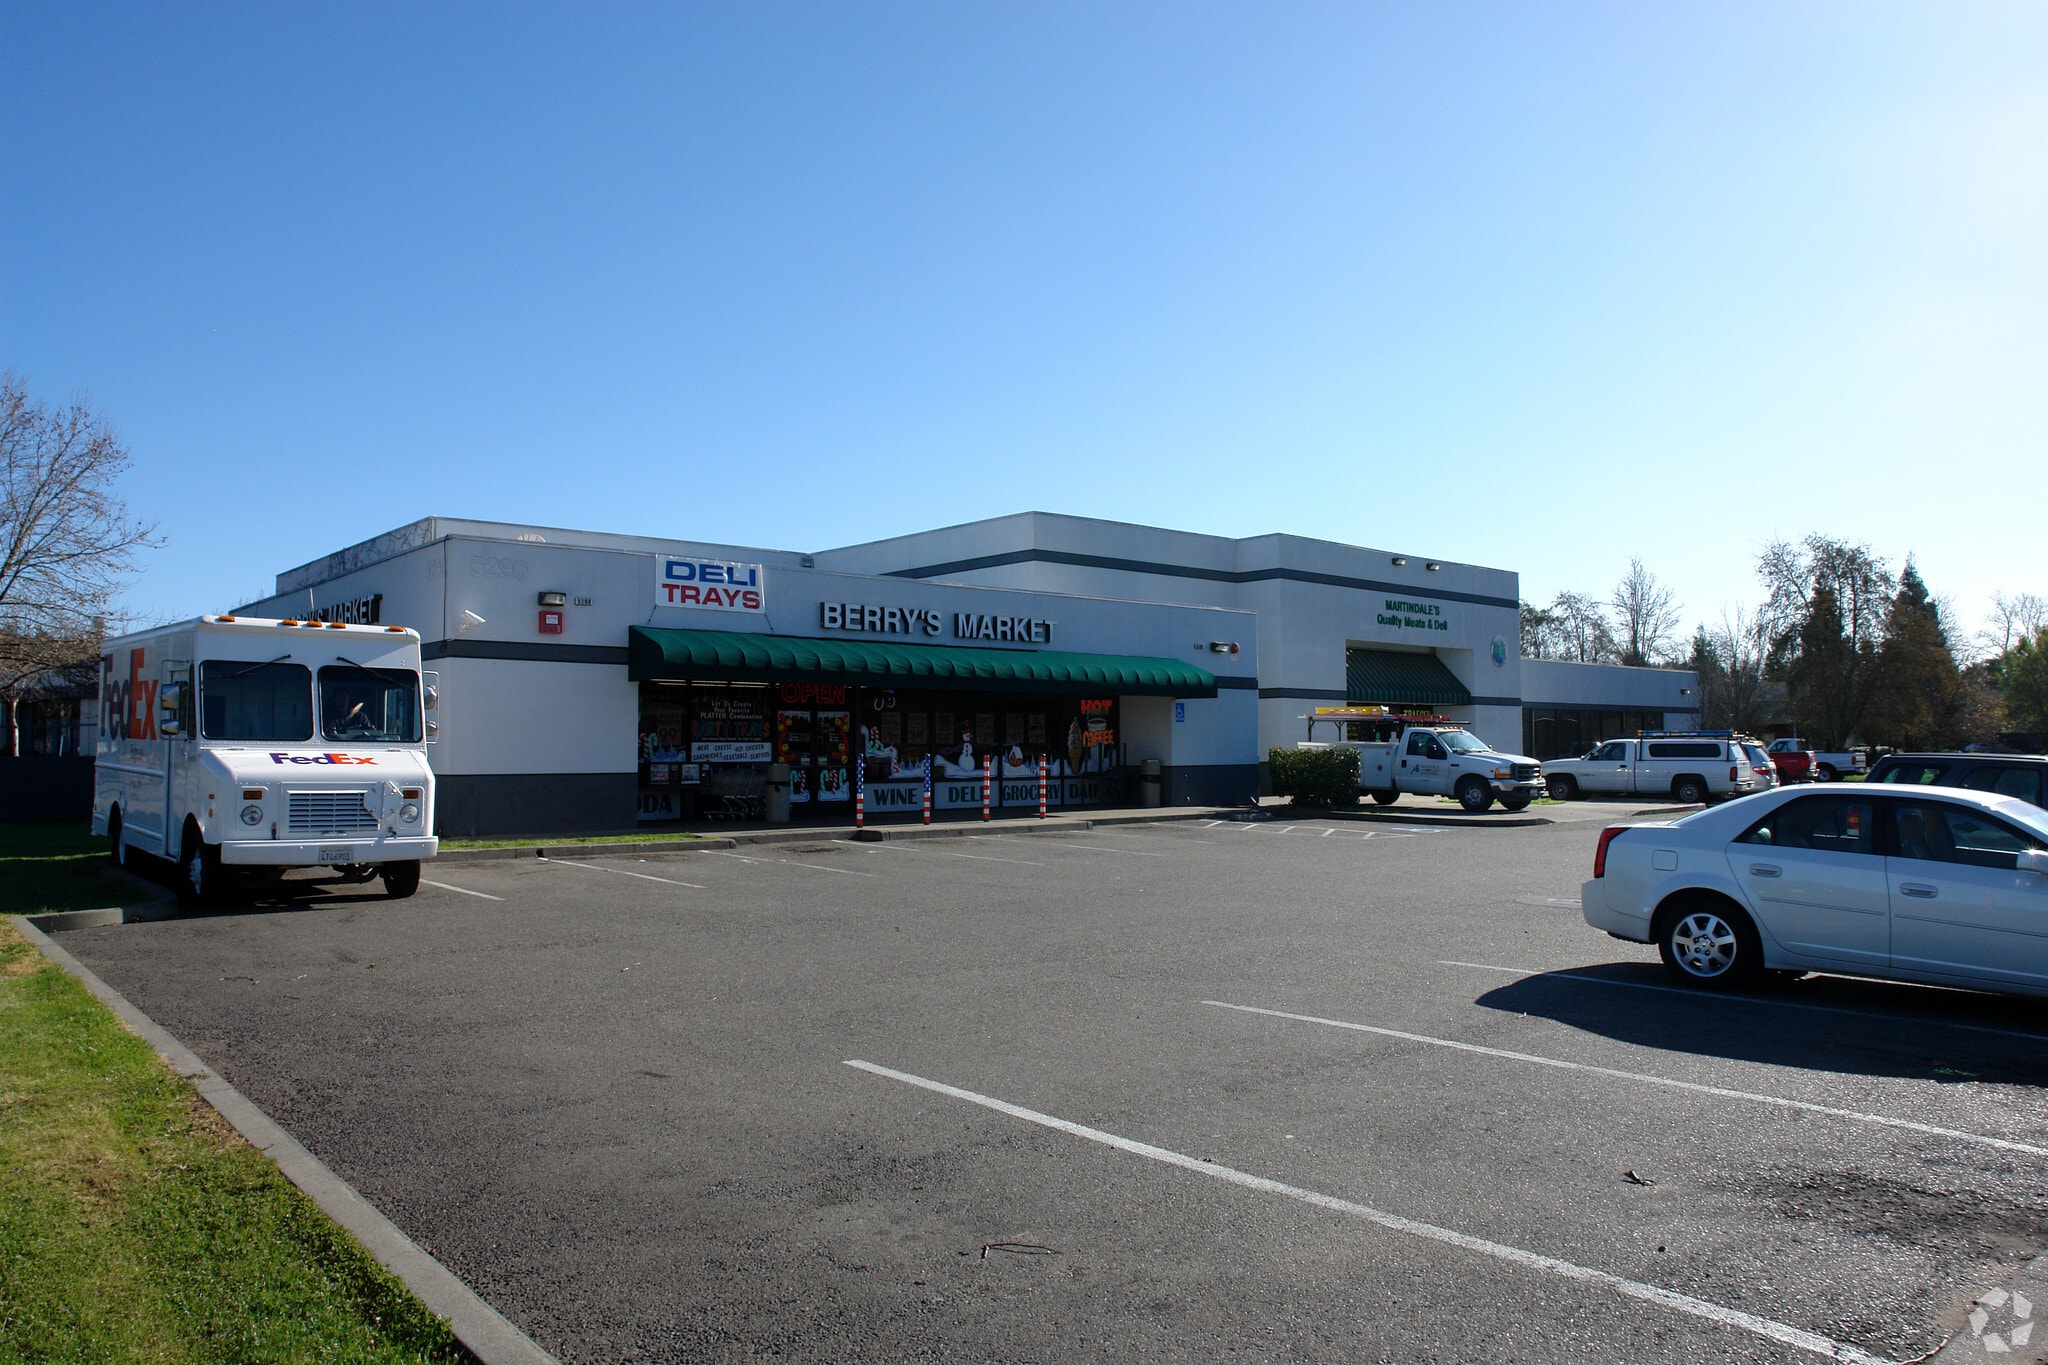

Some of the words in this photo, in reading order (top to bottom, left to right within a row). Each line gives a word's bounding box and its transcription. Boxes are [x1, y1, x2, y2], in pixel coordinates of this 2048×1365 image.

[665, 561, 756, 587] DELI
[662, 583, 760, 610] TRAYS
[1385, 600, 1440, 616] MARTINDALE'S
[822, 602, 942, 637] BERRY'S
[953, 613, 1058, 643] MARKET
[1377, 613, 1402, 629] Quality
[1404, 616, 1426, 629] Meats
[1427, 619, 1434, 630] &
[1435, 620, 1448, 631] Deli
[100, 648, 159, 741] FedEx
[780, 682, 846, 704] OPEN
[1080, 699, 1113, 715] HOT
[269, 753, 379, 765] FedEx
[874, 788, 918, 805] WINE
[1003, 784, 1060, 801] GROCRY
